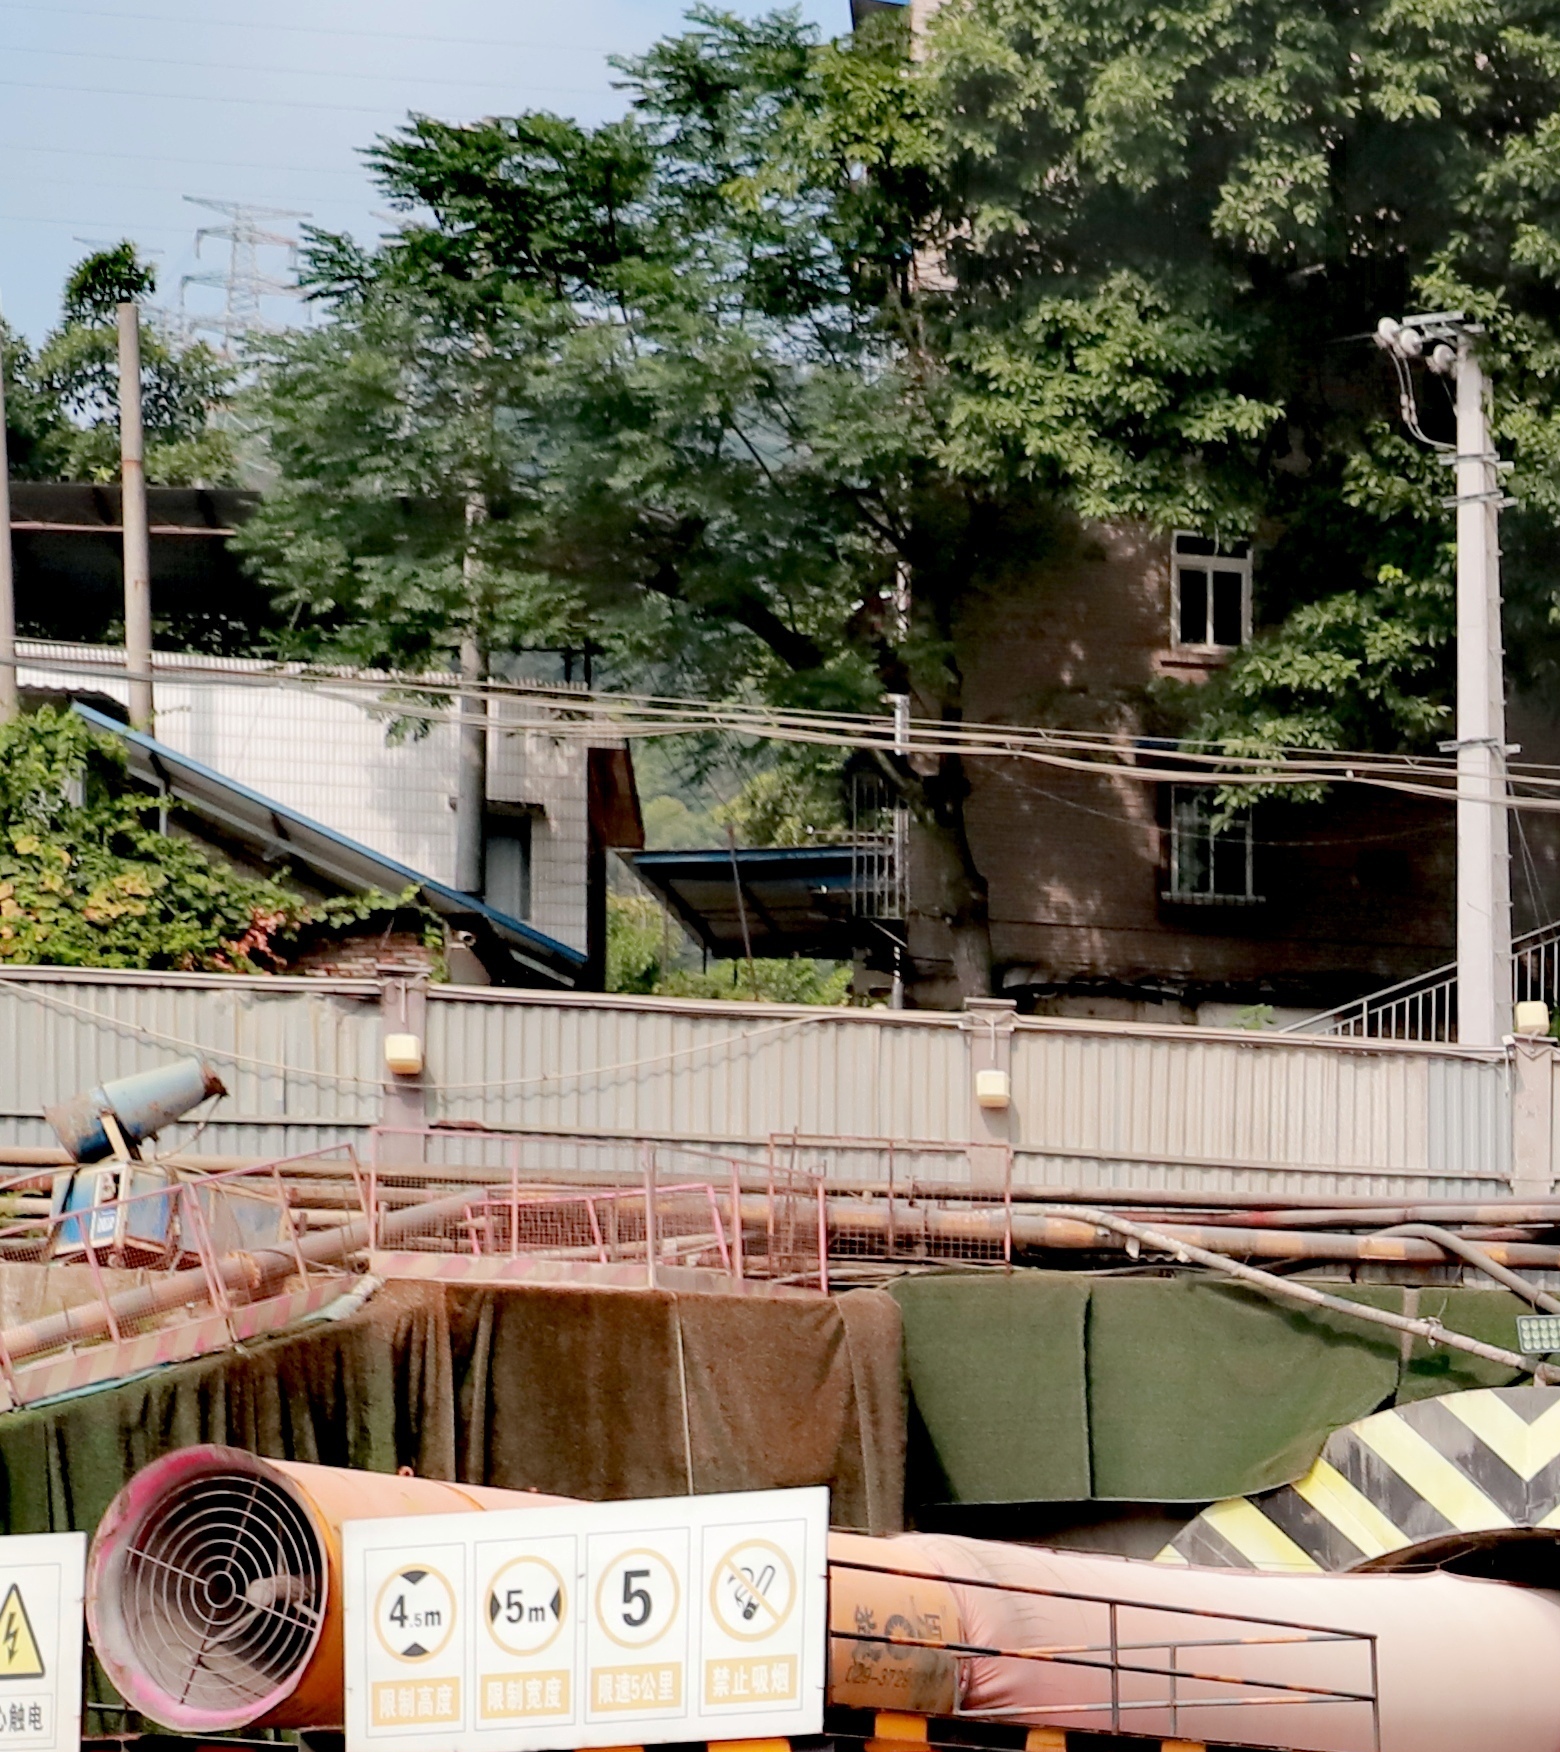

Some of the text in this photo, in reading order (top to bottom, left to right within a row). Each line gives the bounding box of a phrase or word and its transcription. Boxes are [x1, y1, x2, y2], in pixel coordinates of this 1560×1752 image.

[389, 1594, 442, 1628] 4.5m
[505, 1589, 547, 1624] 5m
[622, 1569, 653, 1628] 5
[486, 1678, 563, 1713] 限制宽度
[598, 1670, 675, 1704] 限速5公里
[711, 1661, 791, 1698] 禁止吸烟
[378, 1686, 454, 1719] 限制高度
